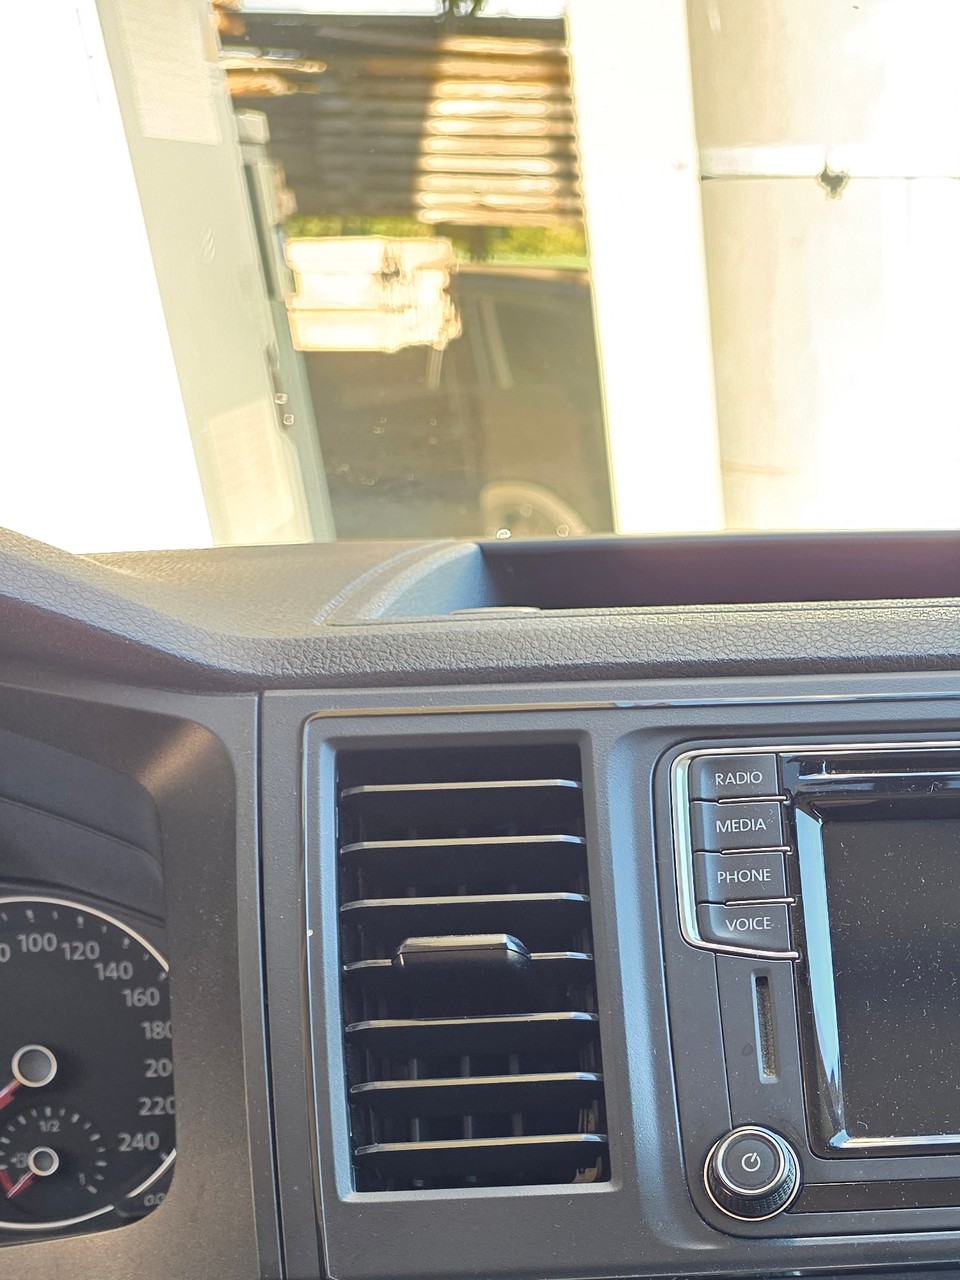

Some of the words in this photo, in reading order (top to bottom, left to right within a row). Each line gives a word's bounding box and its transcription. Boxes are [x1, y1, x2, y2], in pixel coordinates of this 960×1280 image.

[715, 771, 763, 785] RADIO
[716, 818, 767, 833] MEDIA
[717, 868, 772, 884] PHONE
[725, 916, 772, 931] VOICE
[17, 933, 58, 952] 100
[61, 941, 100, 960] 120
[0, 943, 11, 963] 0
[94, 961, 133, 980] 140
[121, 987, 160, 1007] 160
[144, 1058, 173, 1078] 20
[39, 1120, 60, 1133] 1/2
[118, 1131, 160, 1151] 240
